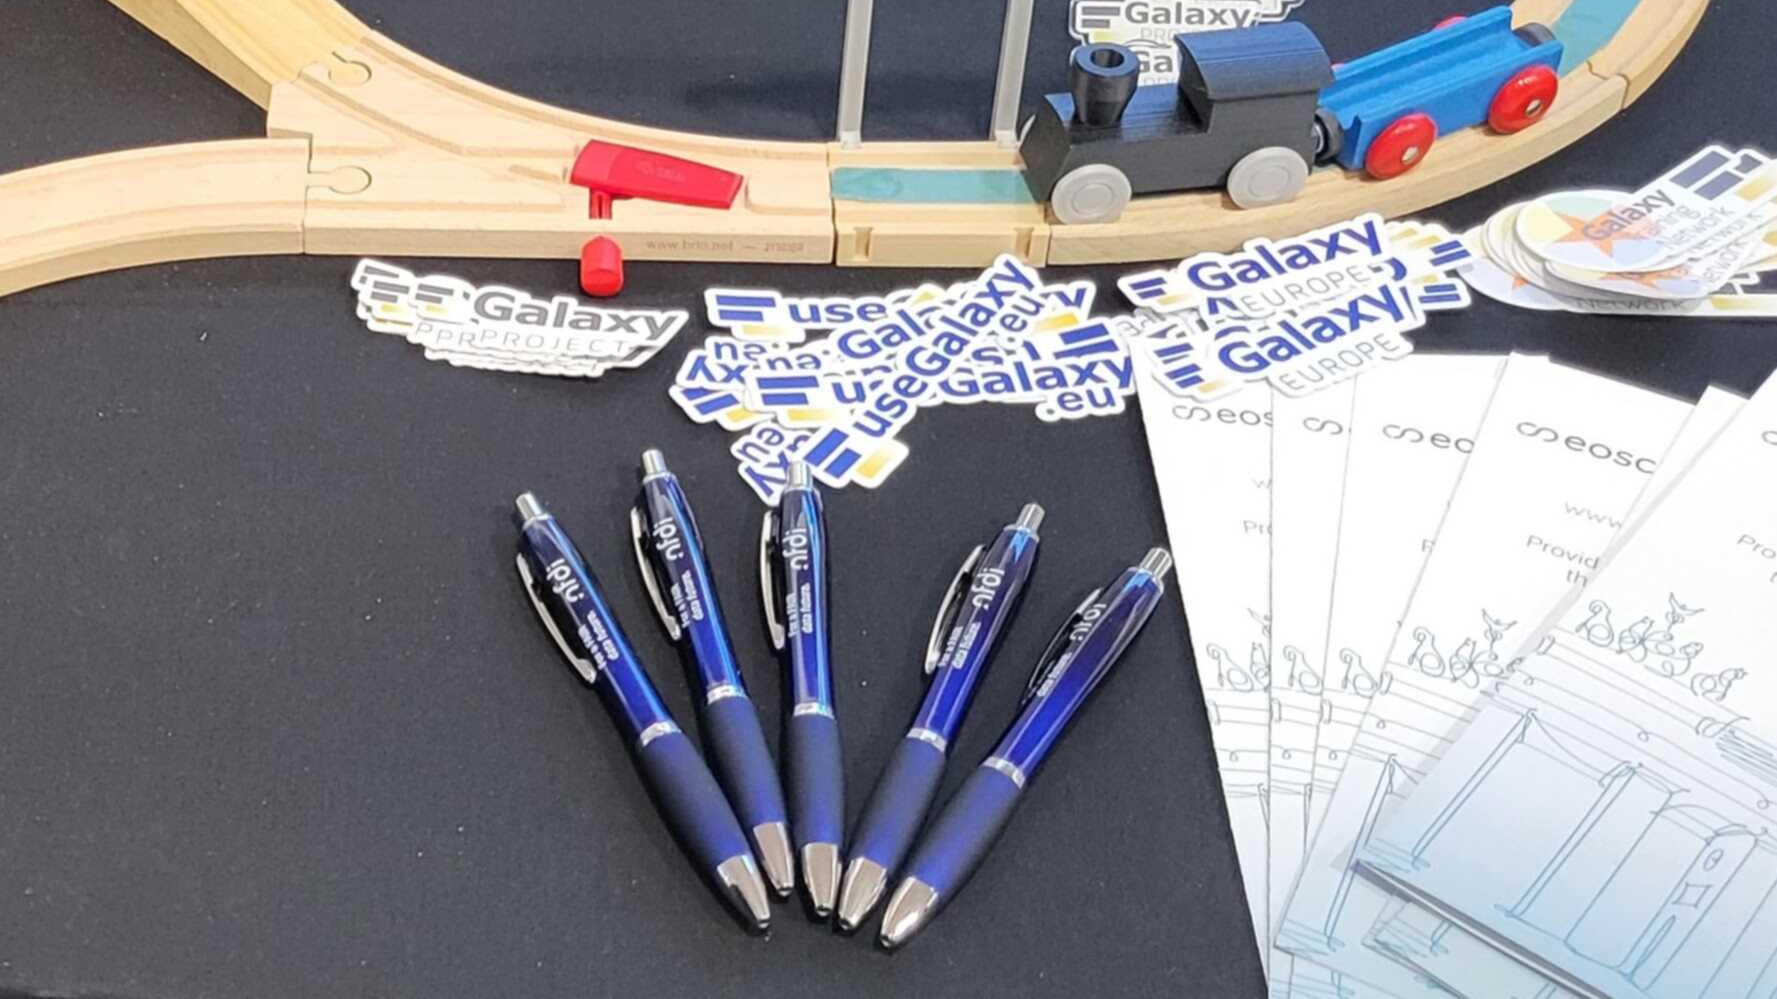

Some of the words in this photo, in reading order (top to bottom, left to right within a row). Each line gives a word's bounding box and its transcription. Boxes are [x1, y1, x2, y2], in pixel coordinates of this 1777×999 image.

[1125, 1, 1251, 26] Galaxy
[1584, 189, 1676, 240] Galaxy
[1188, 220, 1384, 293] Galaxy
[1241, 264, 1371, 312] EUROPE
[474, 290, 677, 341] Galaxy
[838, 309, 926, 359] Gal
[1219, 284, 1404, 374] Galaxy
[480, 328, 630, 354] PROJECT
[1280, 332, 1400, 390] EUROPE
[938, 356, 1133, 397] Galaxy
[1217, 408, 1273, 428] eos
[1430, 431, 1476, 455] eo
[1565, 434, 1657, 475] eosc
[653, 517, 684, 561] nfdi
[782, 528, 809, 571] nfdi
[1526, 534, 1600, 571] Provid
[545, 557, 585, 604] nfdi
[971, 567, 1006, 611] nfdi
[1566, 568, 1589, 588] th
